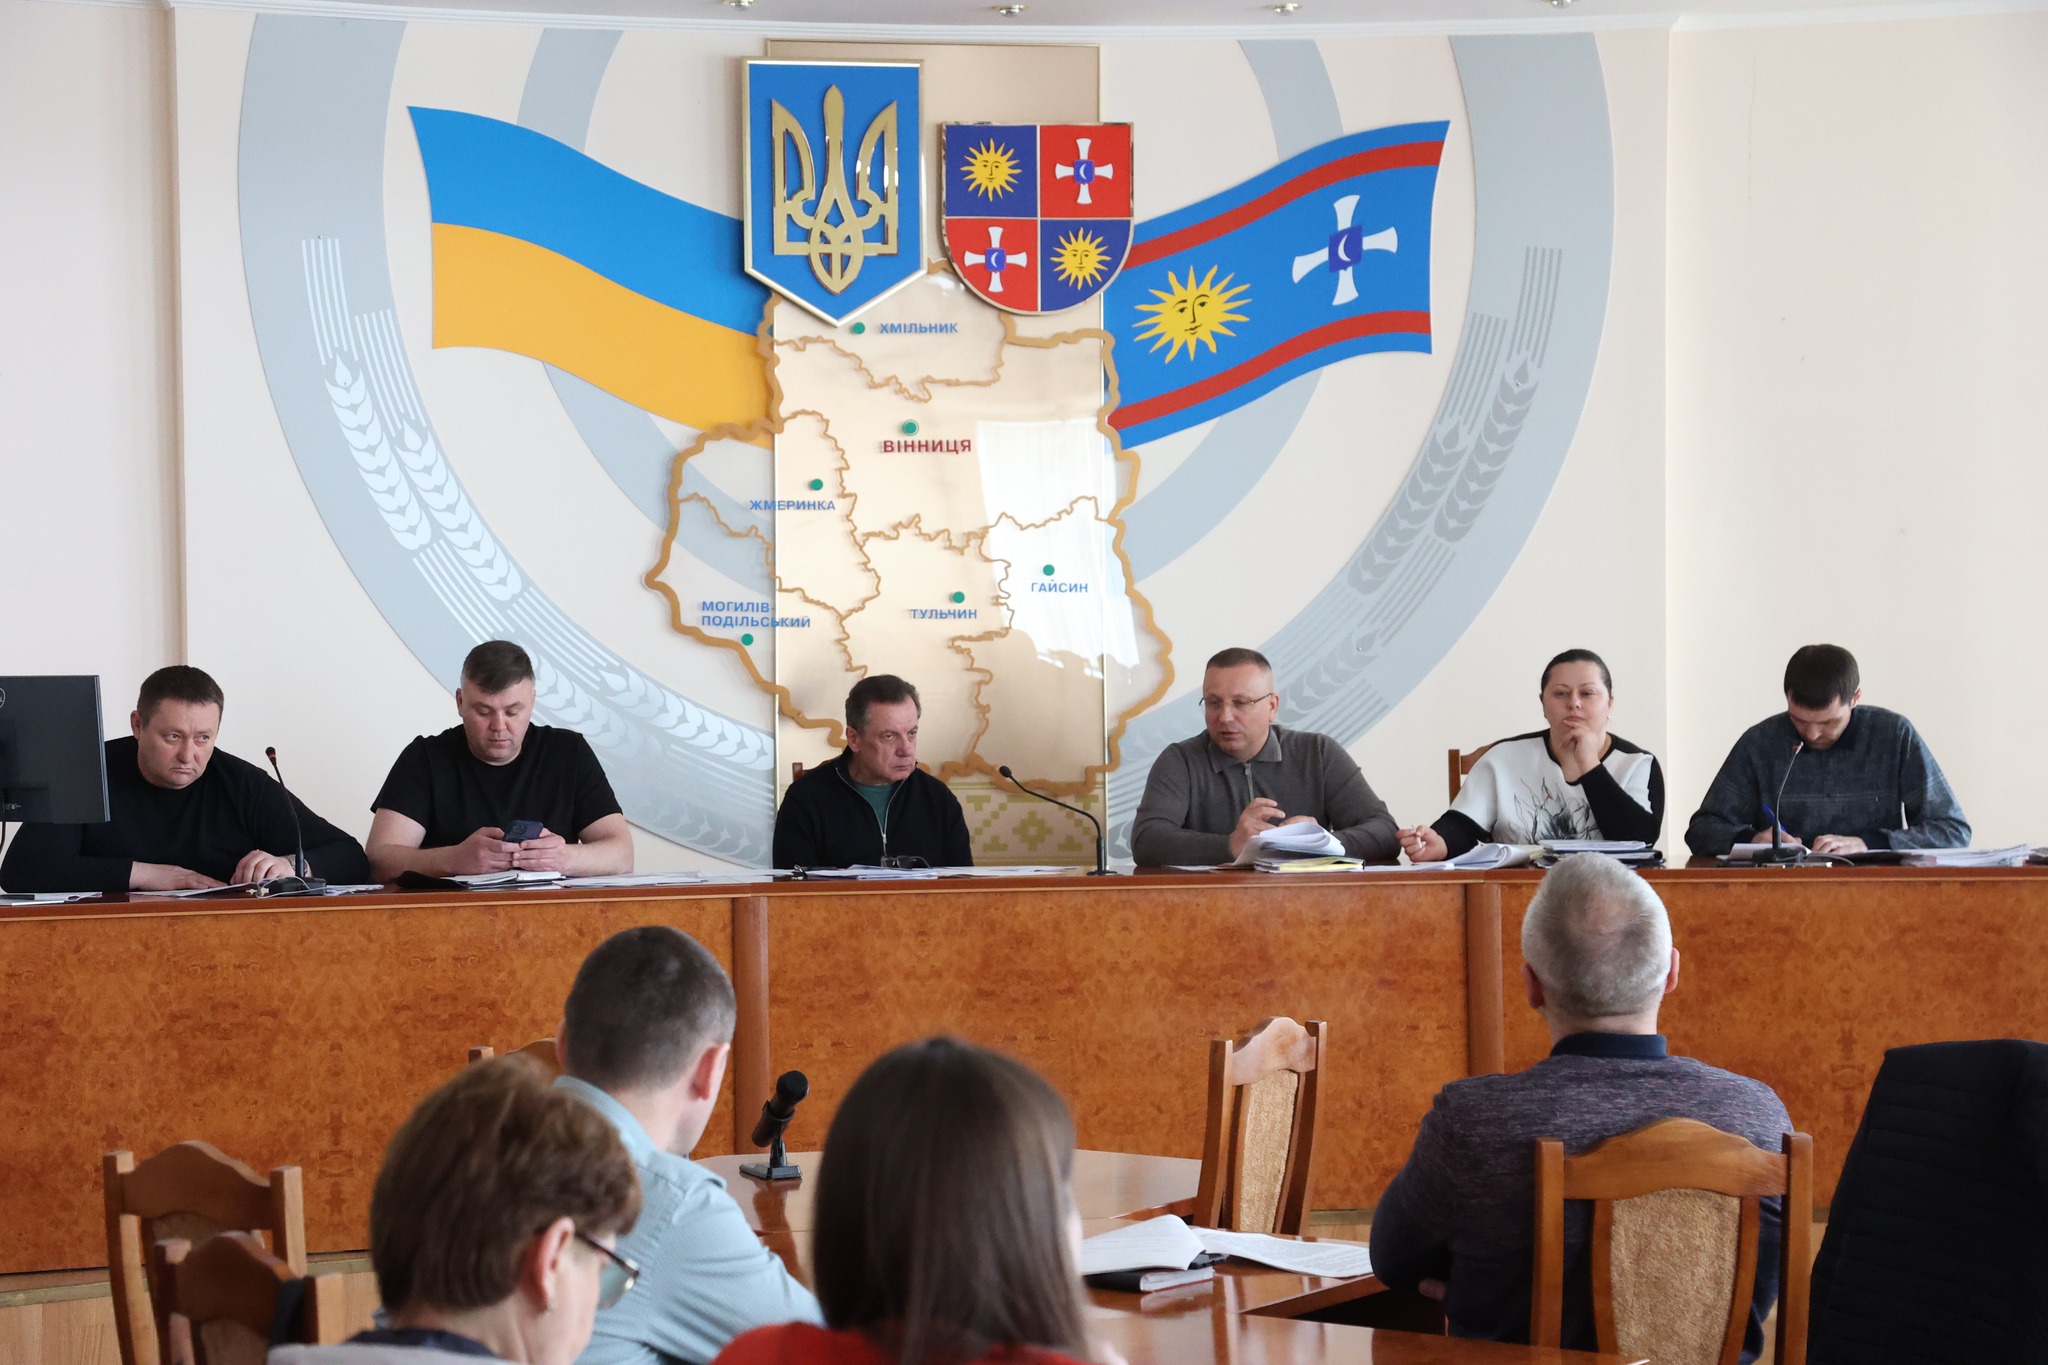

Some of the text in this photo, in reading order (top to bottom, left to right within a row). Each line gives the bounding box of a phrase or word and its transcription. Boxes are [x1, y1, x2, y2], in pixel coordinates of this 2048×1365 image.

[880, 322, 958, 334] ХМІЛЬНИК
[883, 439, 971, 455] ВІННИЦЯ
[749, 500, 836, 511] ЖМЕРИНКА
[1031, 579, 1088, 593] ГАЙСИН
[910, 608, 977, 619] ТУЛЬЧИН
[701, 615, 811, 628] ПОДІЛЬСЬКИЙ
